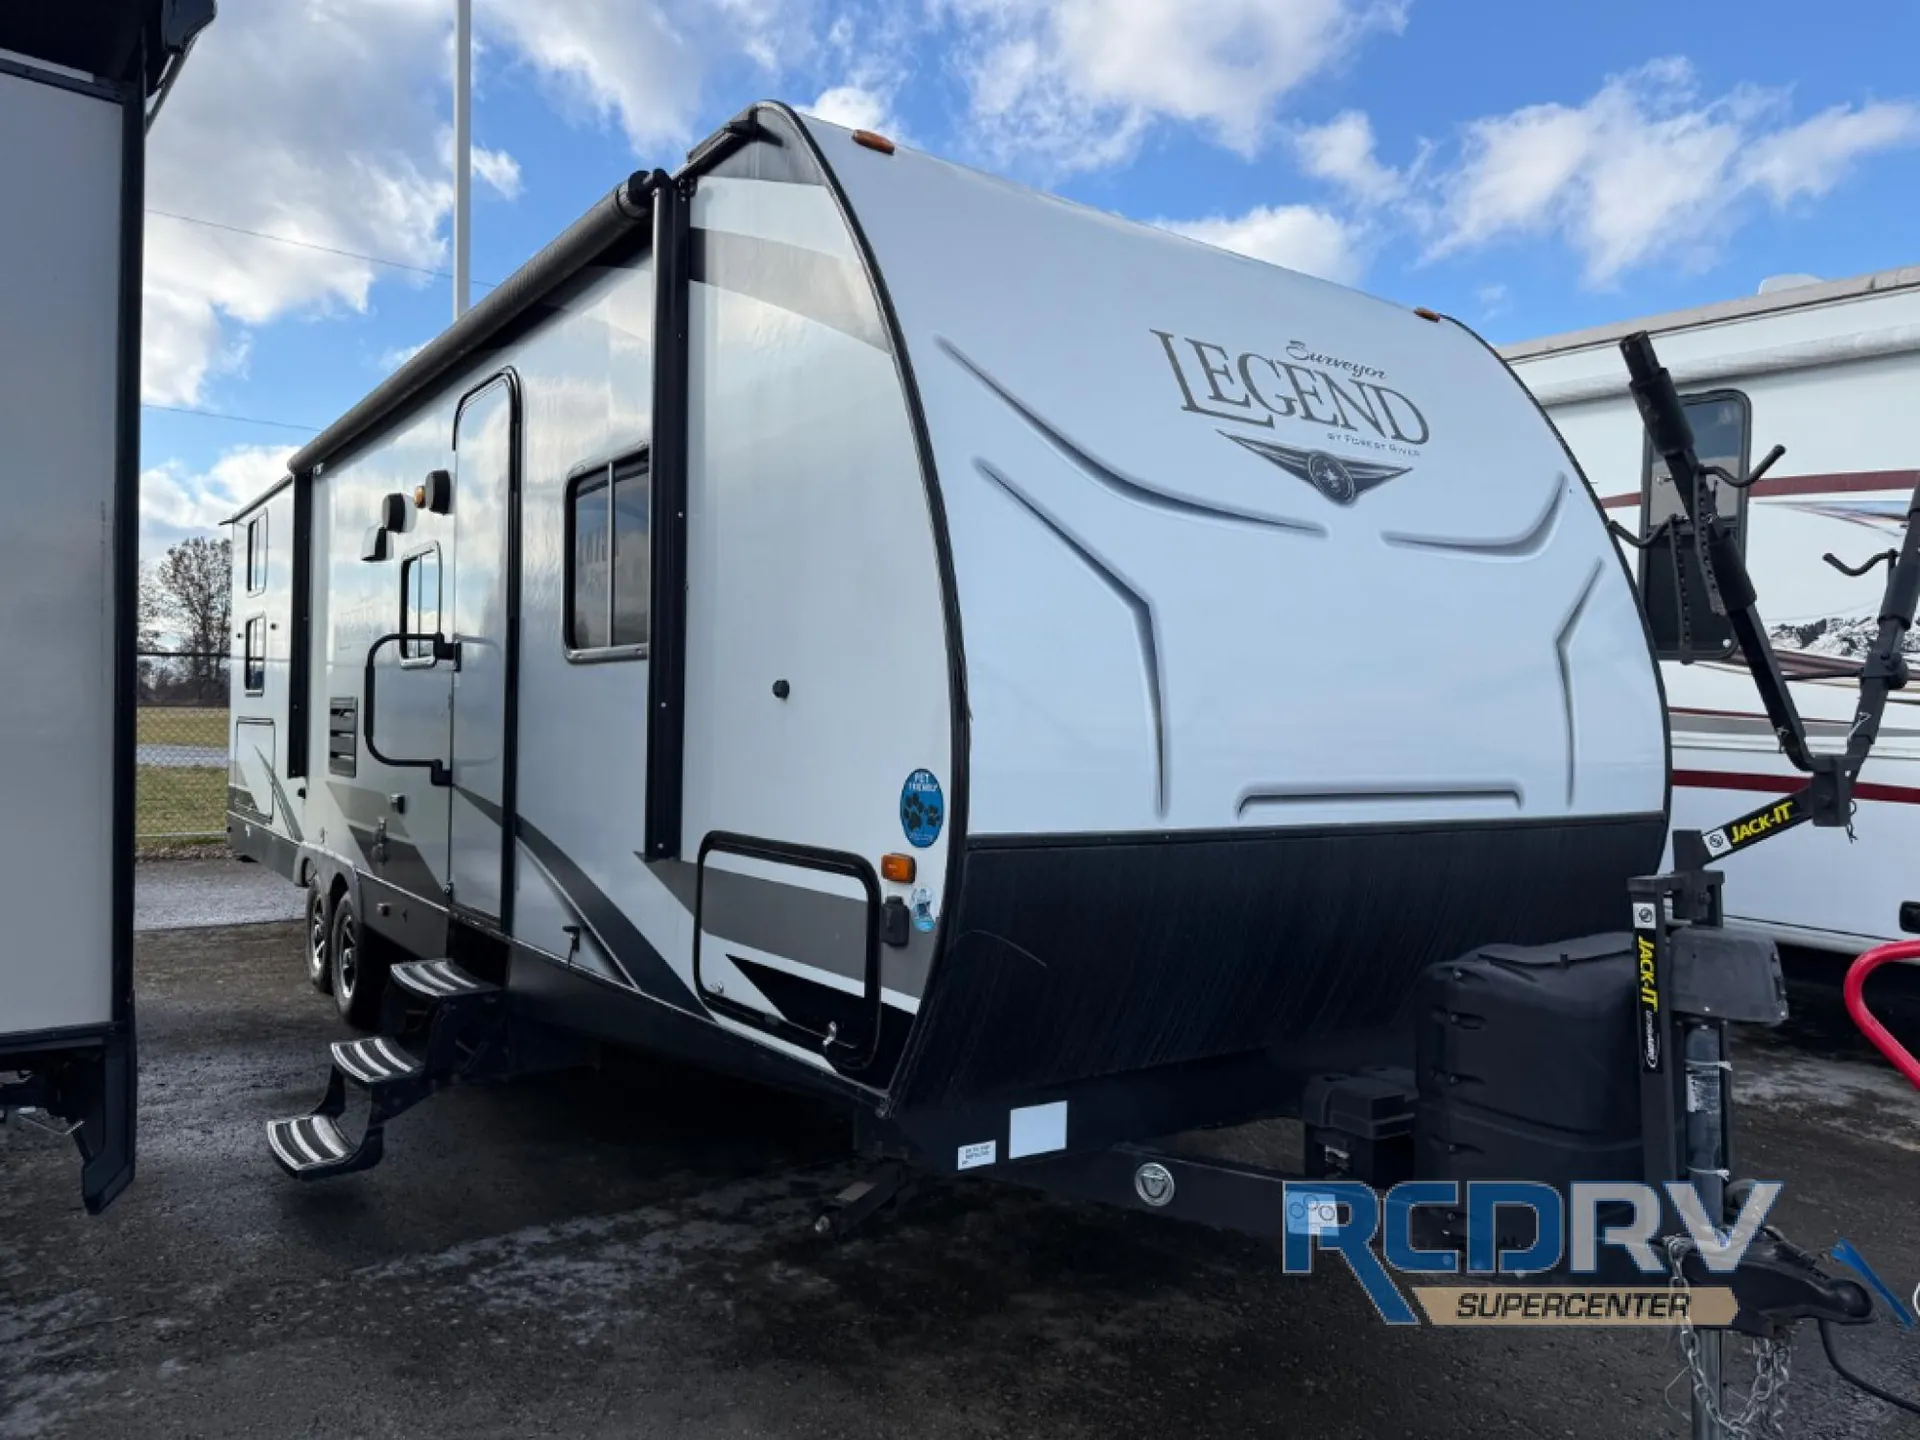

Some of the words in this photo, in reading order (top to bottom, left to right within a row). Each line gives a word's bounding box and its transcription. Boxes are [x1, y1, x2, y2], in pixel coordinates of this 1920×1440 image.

[1285, 339, 1386, 380] Surveyor
[1149, 328, 1429, 444] LEGEND
[914, 773, 930, 783] PET
[1731, 800, 1794, 844] JACK-IT
[1638, 934, 1659, 1013] JACK-IT
